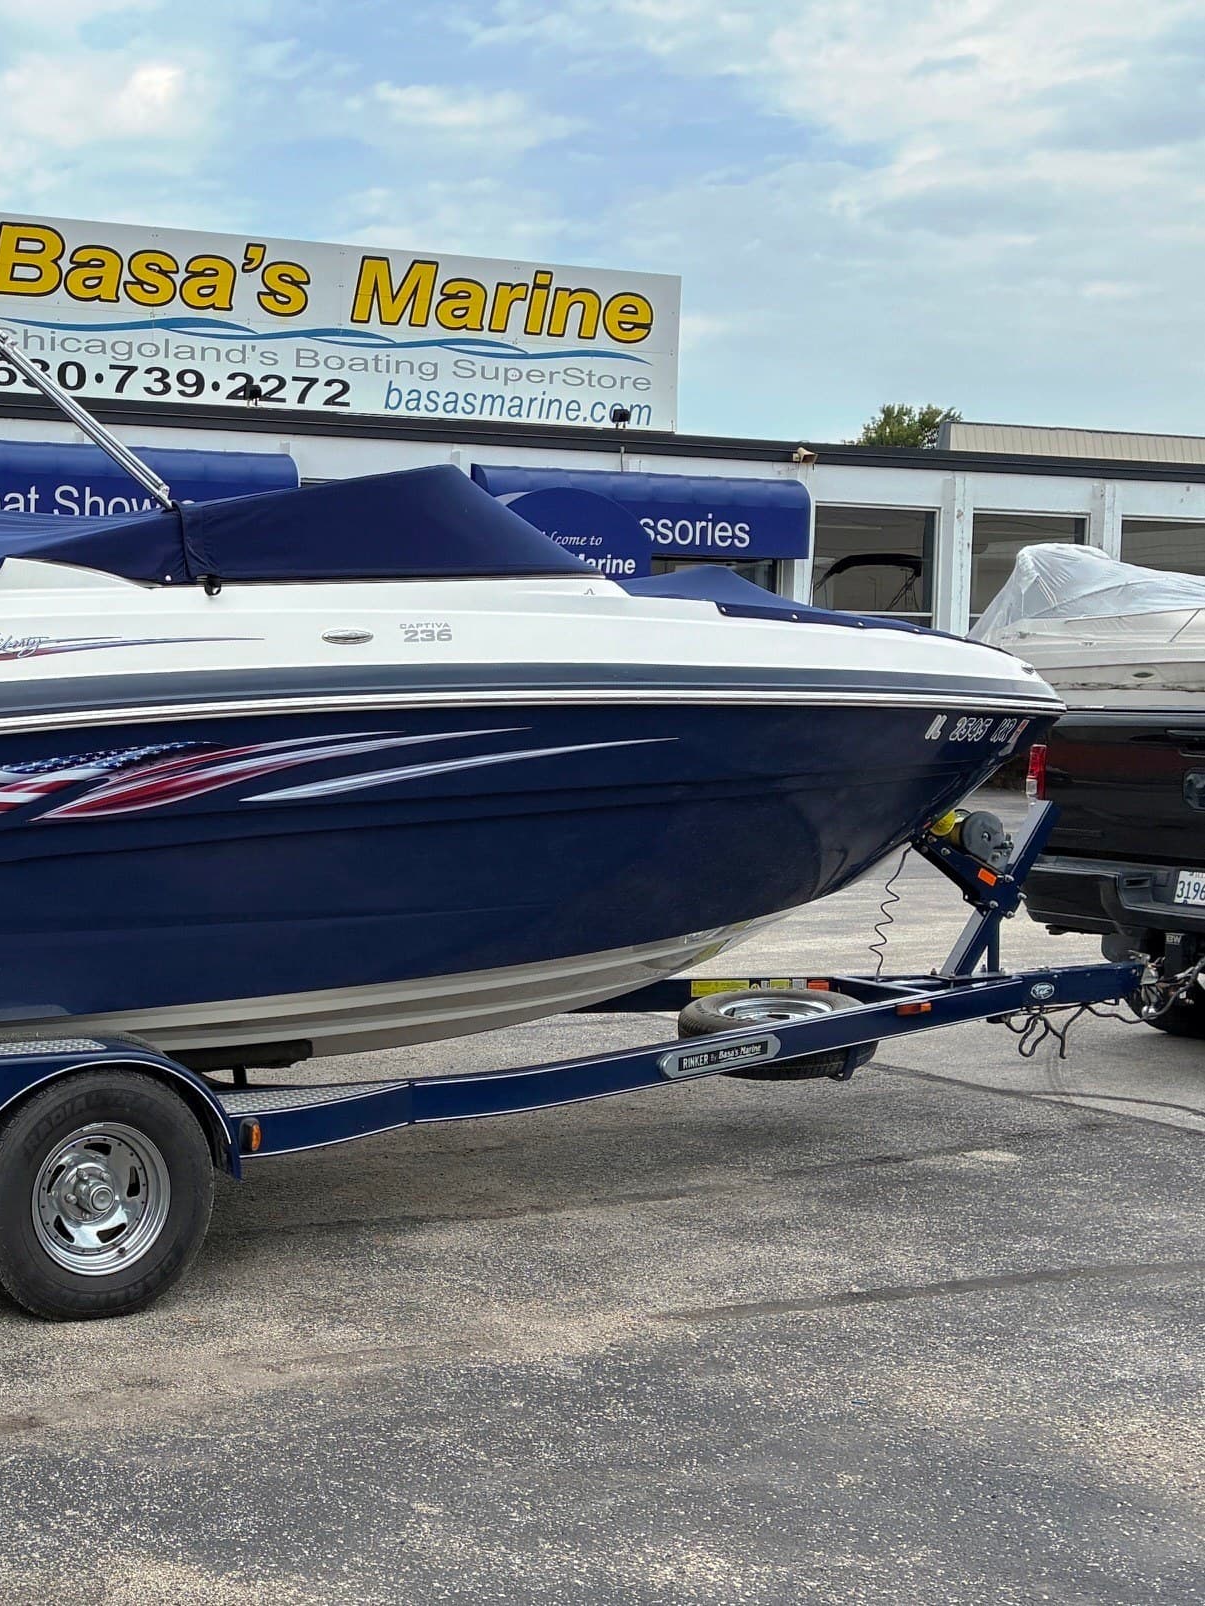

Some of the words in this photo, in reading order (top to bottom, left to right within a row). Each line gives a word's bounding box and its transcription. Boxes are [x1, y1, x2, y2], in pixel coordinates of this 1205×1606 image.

[350, 256, 655, 344] Marine
[295, 347, 439, 382] Boating
[452, 358, 652, 392] SuperStore
[589, 535, 603, 546] to
[572, 553, 636, 574] arine
[399, 622, 451, 630] CAPTIVA
[403, 629, 453, 643] 236
[682, 1053, 709, 1069] RINKER
